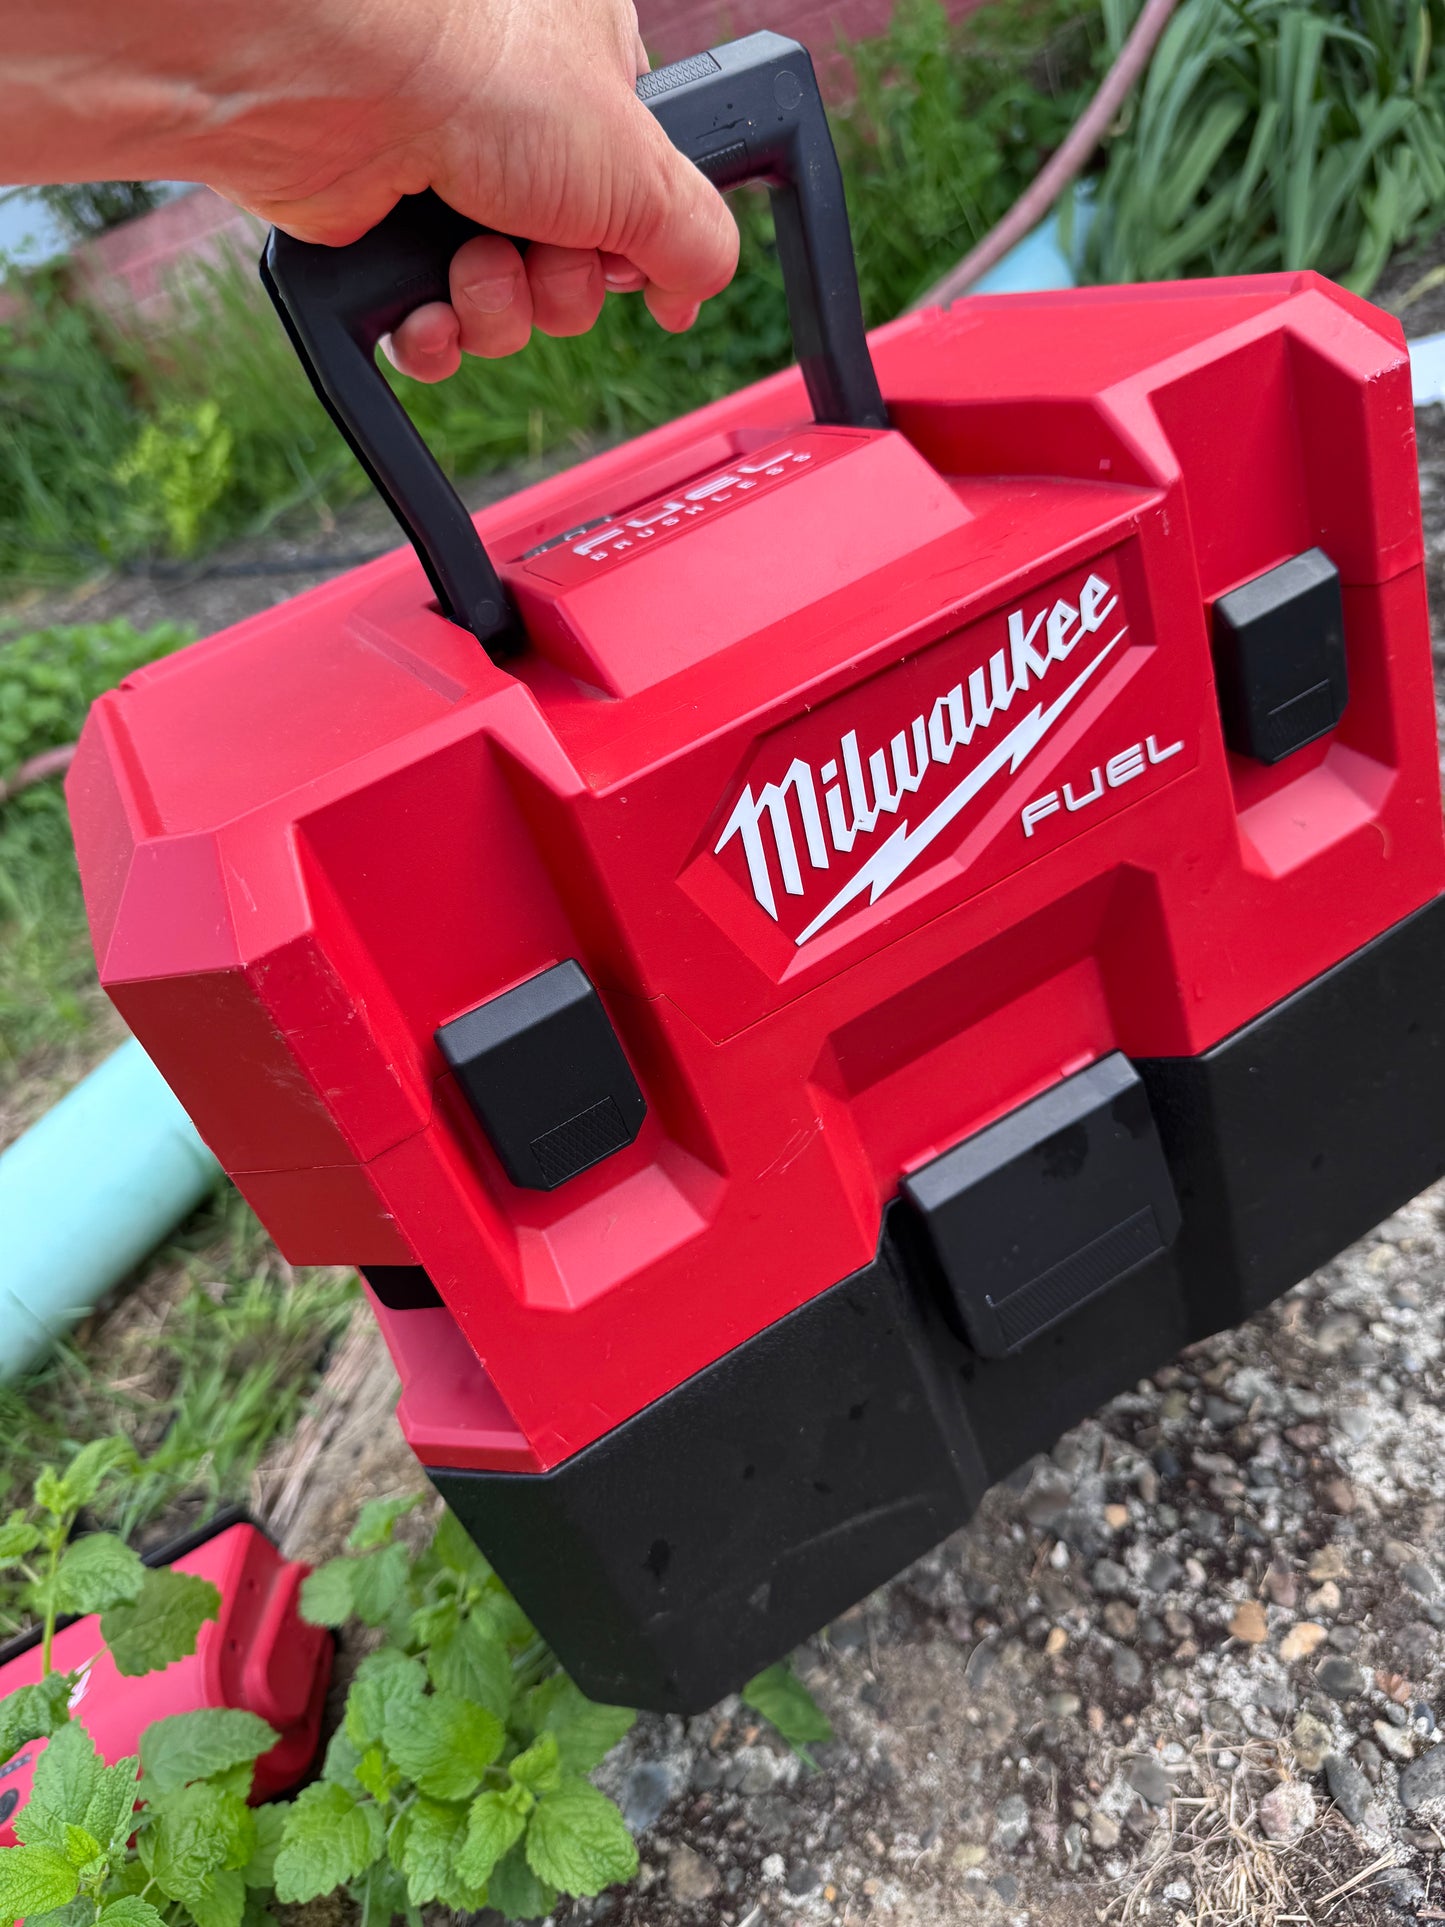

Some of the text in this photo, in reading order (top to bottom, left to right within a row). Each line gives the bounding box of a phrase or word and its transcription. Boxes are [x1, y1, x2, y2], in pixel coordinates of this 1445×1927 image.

[573, 450, 794, 555] FUEL
[590, 453, 811, 560] BRUSHLESS
[714, 574, 1119, 921] Milwaukee
[1020, 734, 1185, 838] FUEL
